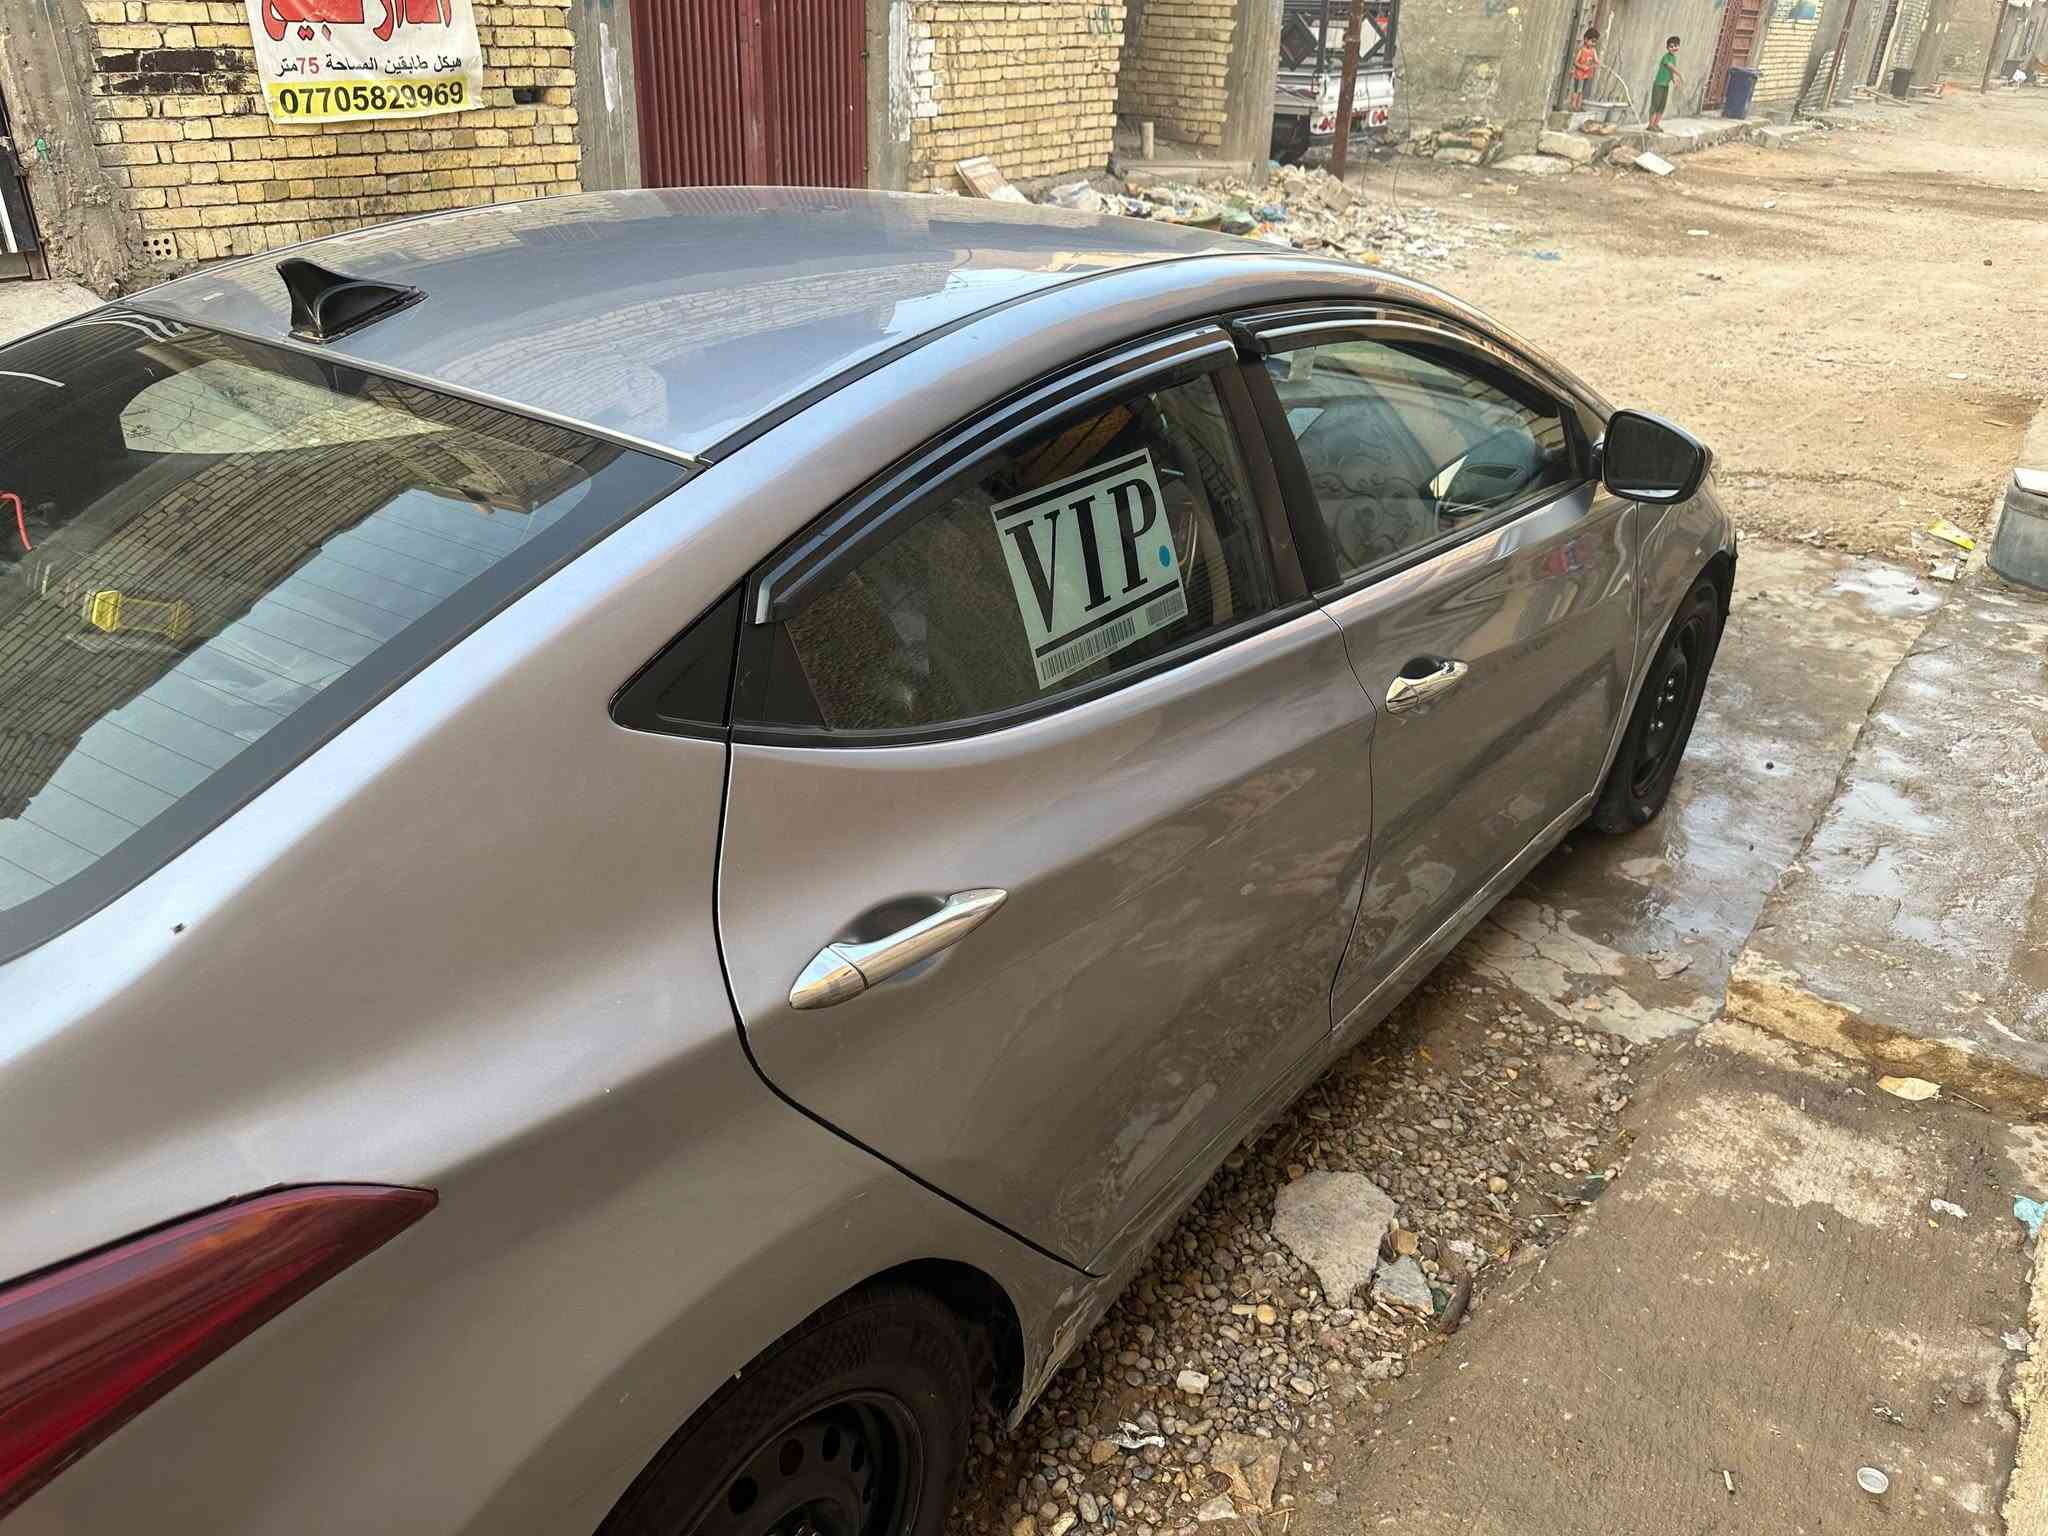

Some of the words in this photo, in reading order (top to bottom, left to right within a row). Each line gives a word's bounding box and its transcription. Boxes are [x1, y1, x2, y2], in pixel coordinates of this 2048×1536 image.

[325, 53, 378, 72] المساحة
[385, 54, 429, 75] طابقين
[434, 55, 462, 73] هيكل
[279, 81, 464, 114] 07705829969
